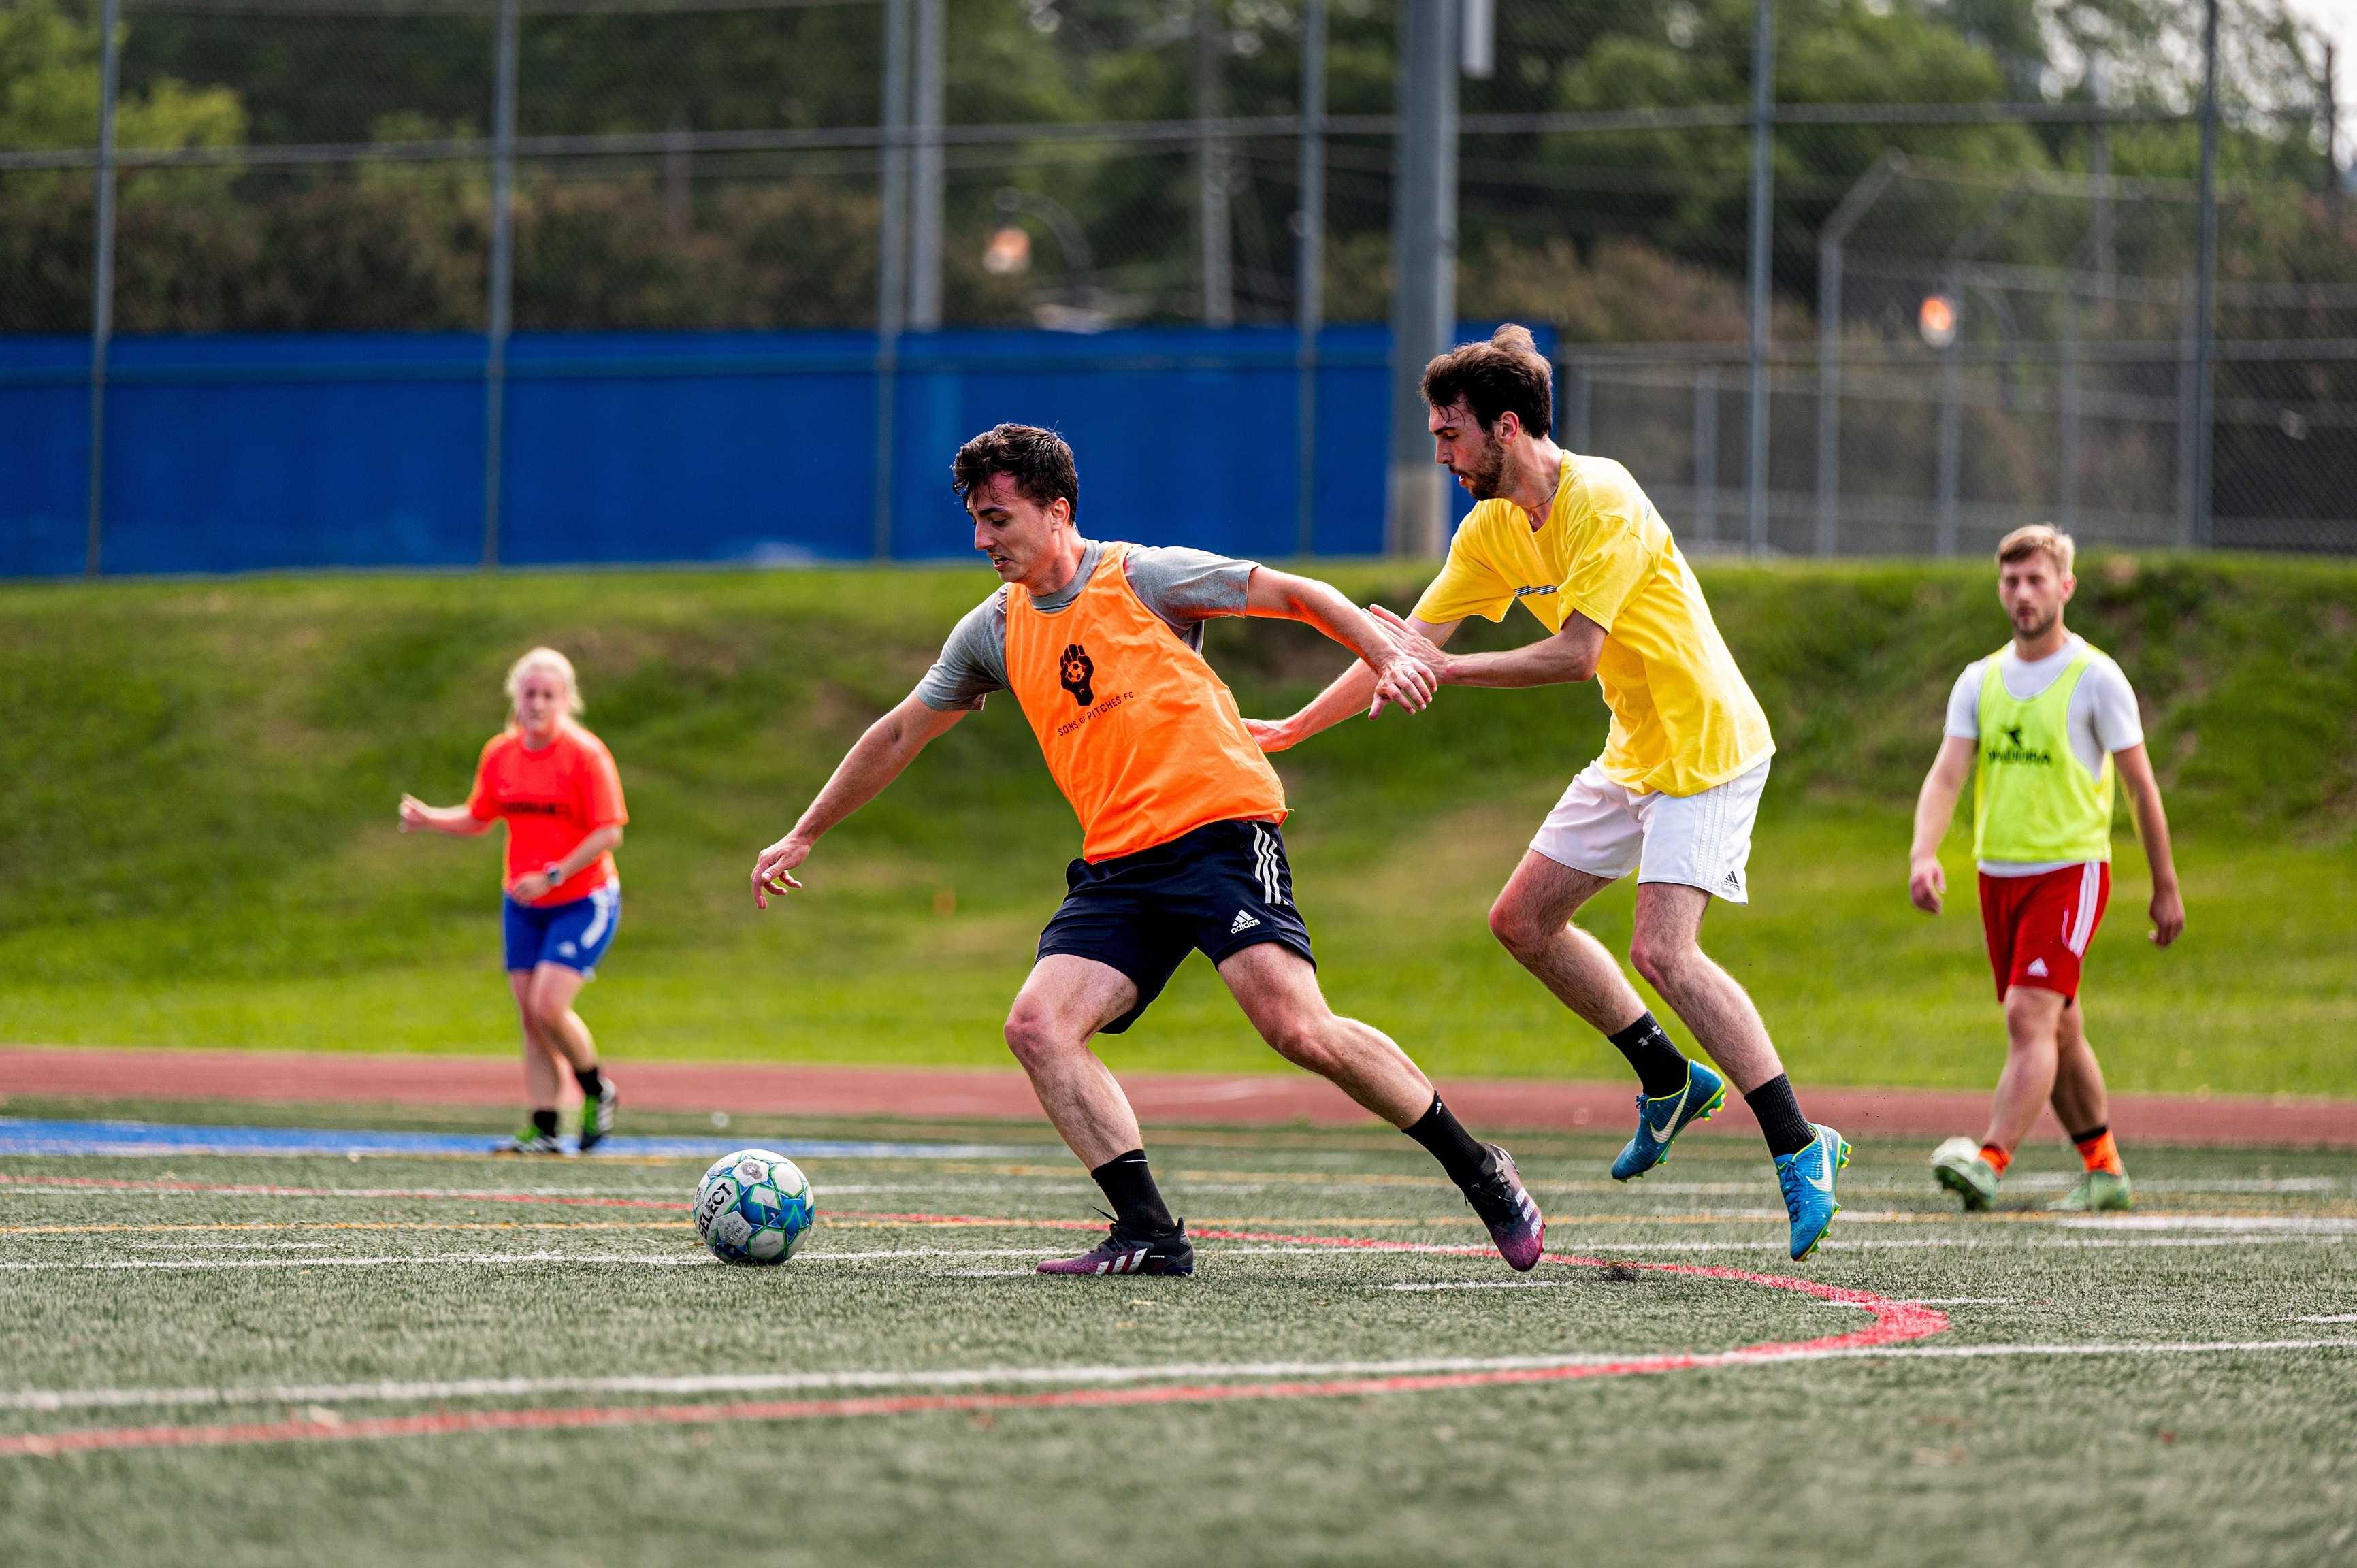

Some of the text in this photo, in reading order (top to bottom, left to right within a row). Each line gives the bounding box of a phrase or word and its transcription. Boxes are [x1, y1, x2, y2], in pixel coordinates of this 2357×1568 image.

[1058, 691, 1134, 736] SONS OF PITCHES FC
[1724, 879, 1740, 892] adidas
[1231, 918, 1261, 934] adidas
[698, 1182, 732, 1241] SELECT
